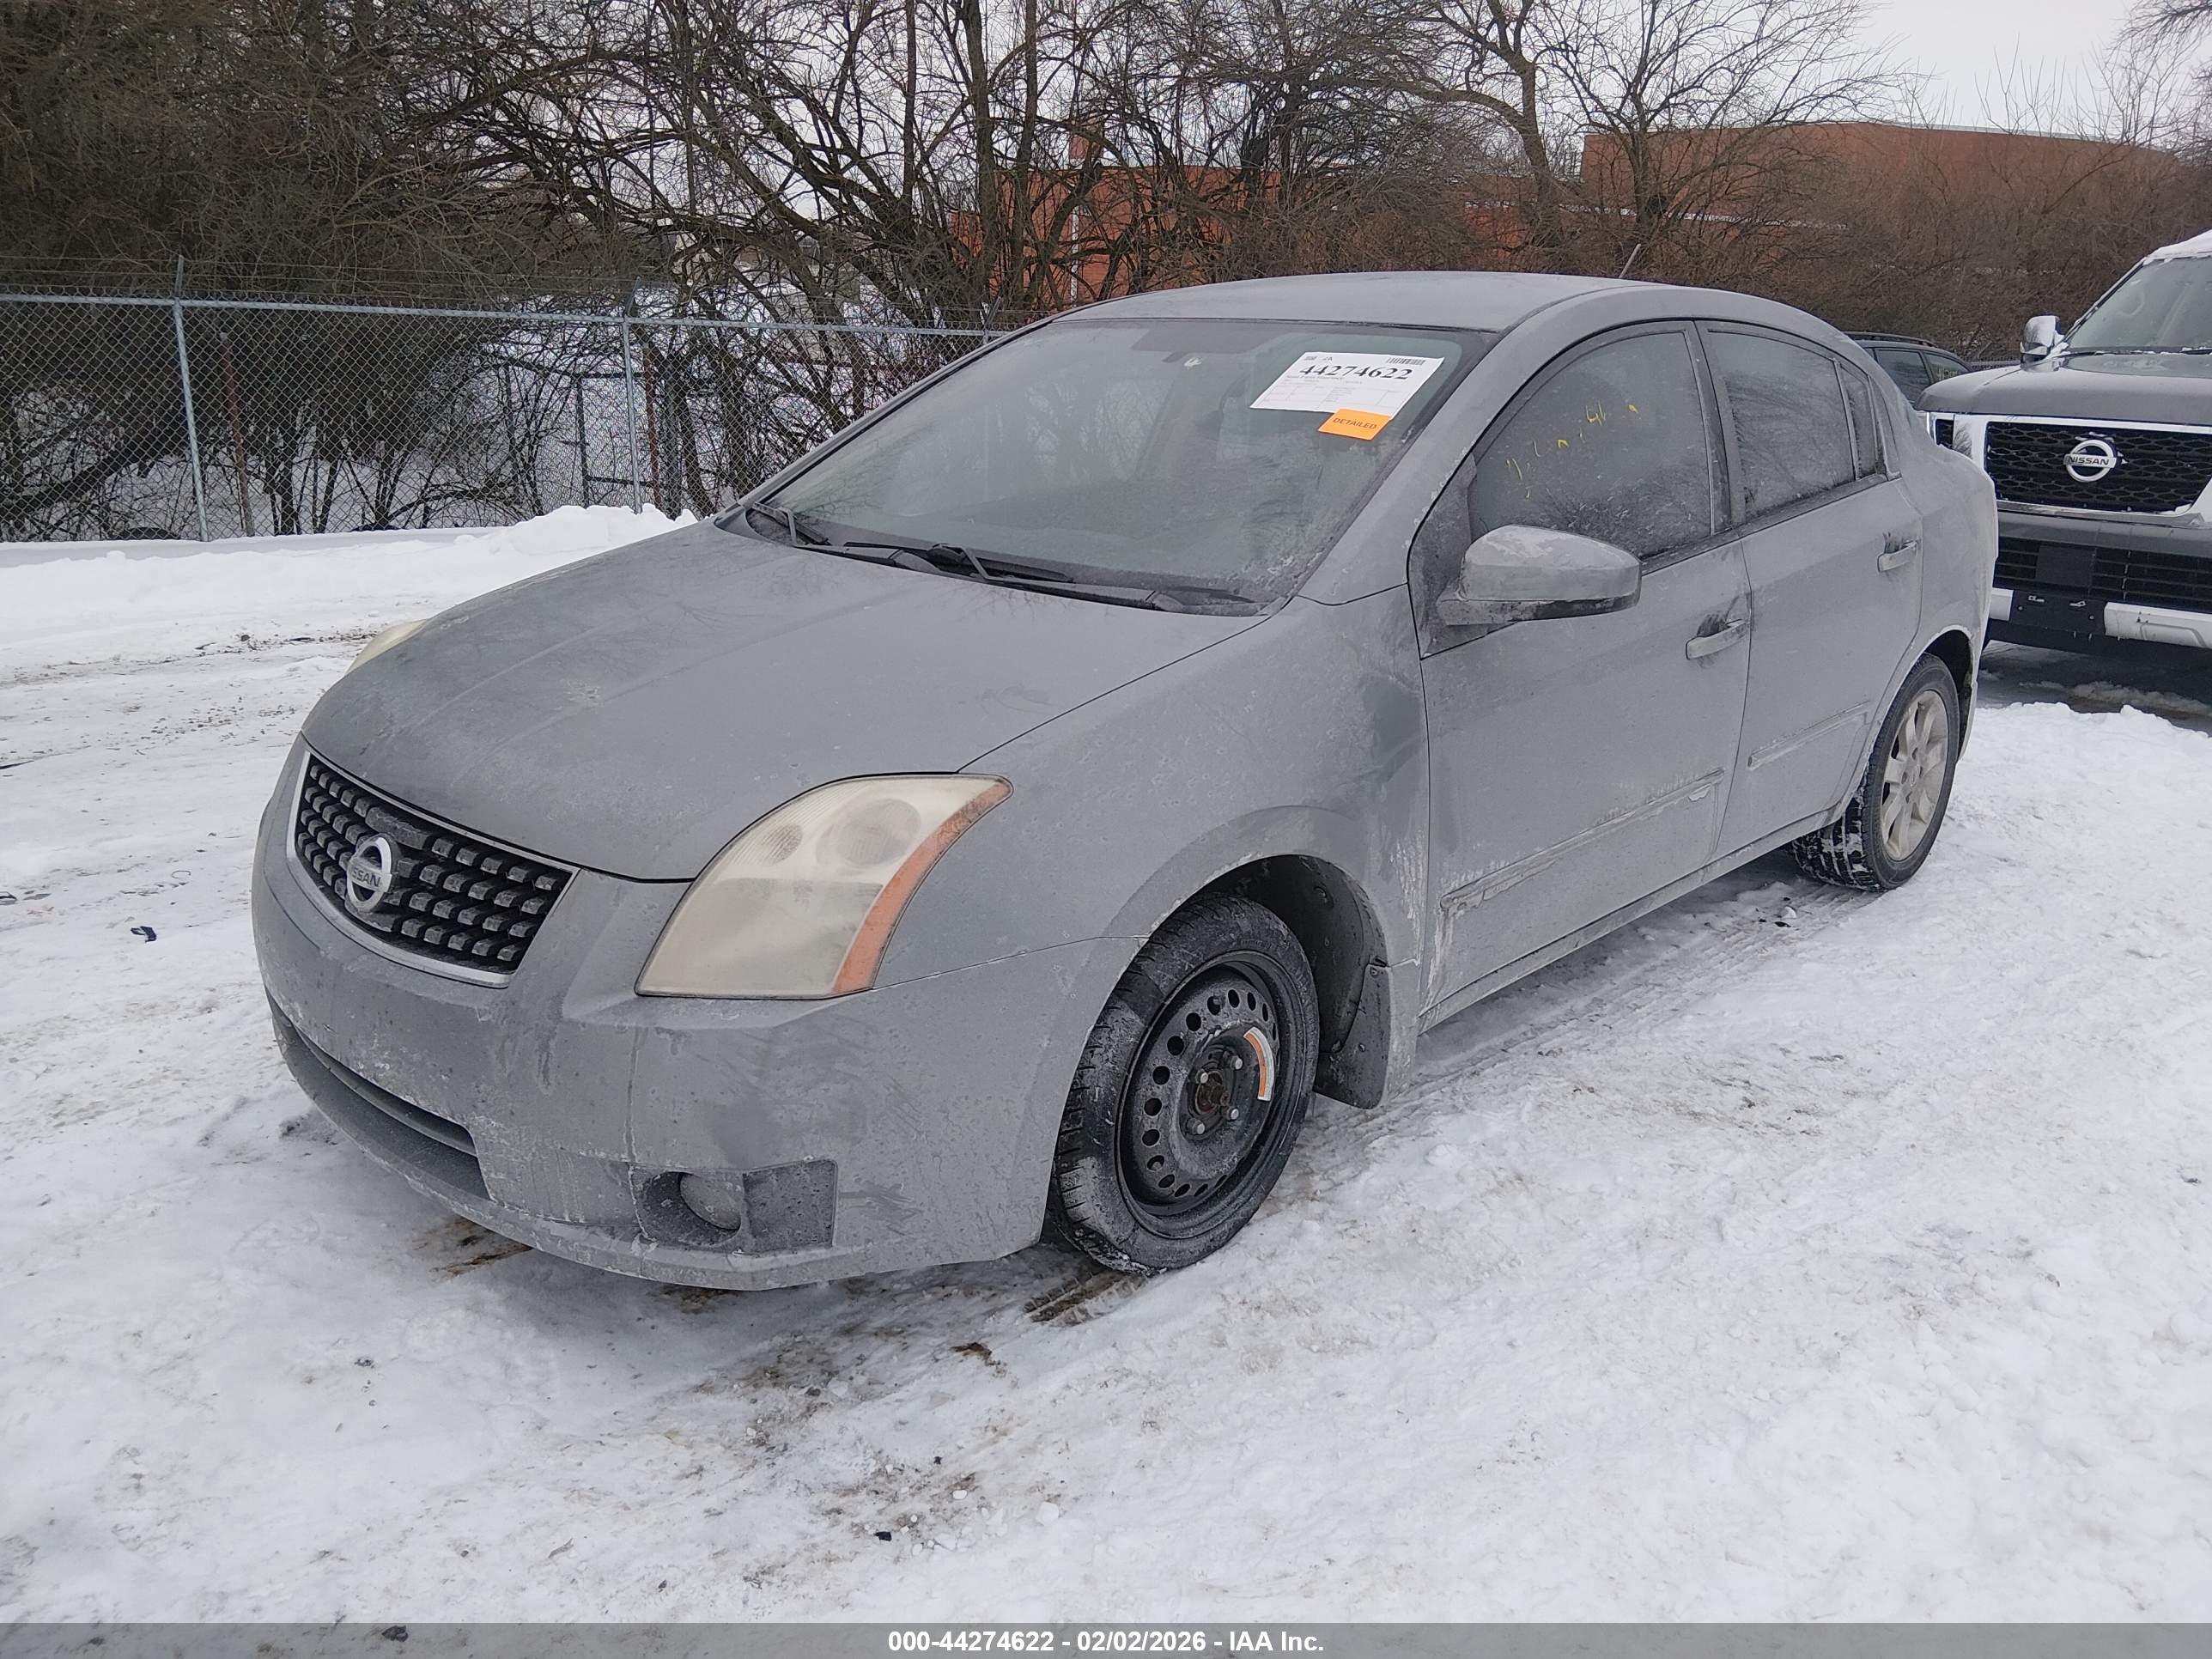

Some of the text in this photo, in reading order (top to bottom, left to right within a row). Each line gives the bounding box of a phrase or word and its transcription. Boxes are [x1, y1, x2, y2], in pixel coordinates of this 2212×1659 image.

[1299, 365, 1413, 380] 44274622
[1333, 417, 1377, 429] DETAILED
[2068, 455, 2110, 466] NISSAN
